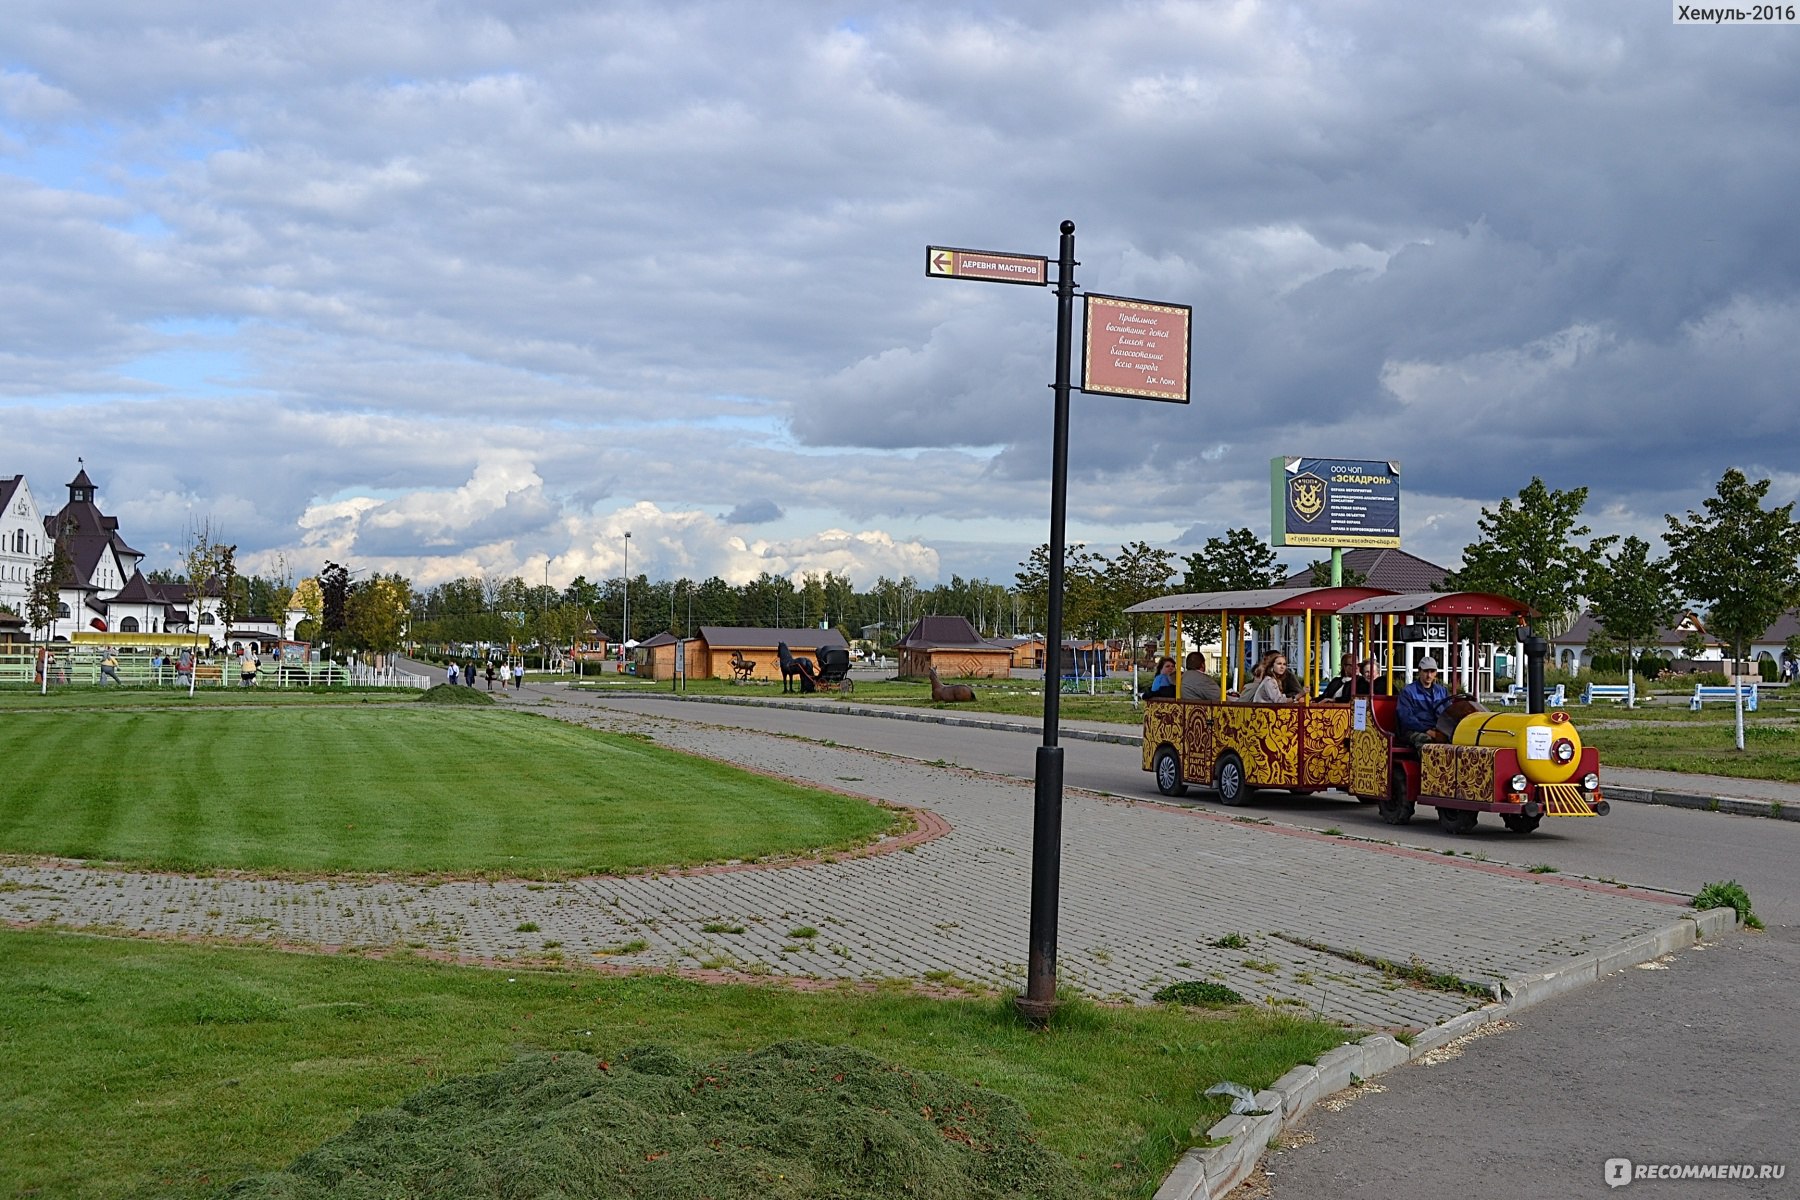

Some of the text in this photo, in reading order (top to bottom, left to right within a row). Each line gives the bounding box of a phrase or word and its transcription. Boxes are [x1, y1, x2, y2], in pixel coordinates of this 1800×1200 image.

[962, 260, 1037, 274] ДЕРЕВНЯ МАСТЕРОВ
[1118, 312, 1158, 325] Правильное
[1114, 358, 1159, 374] всего народа
[1146, 375, 1176, 386] Дж. Локк
[1330, 465, 1363, 474] ООО ЧОП
[1331, 474, 1392, 485] «ЭСКАДРОН»
[1557, 713, 1564, 722] 2
